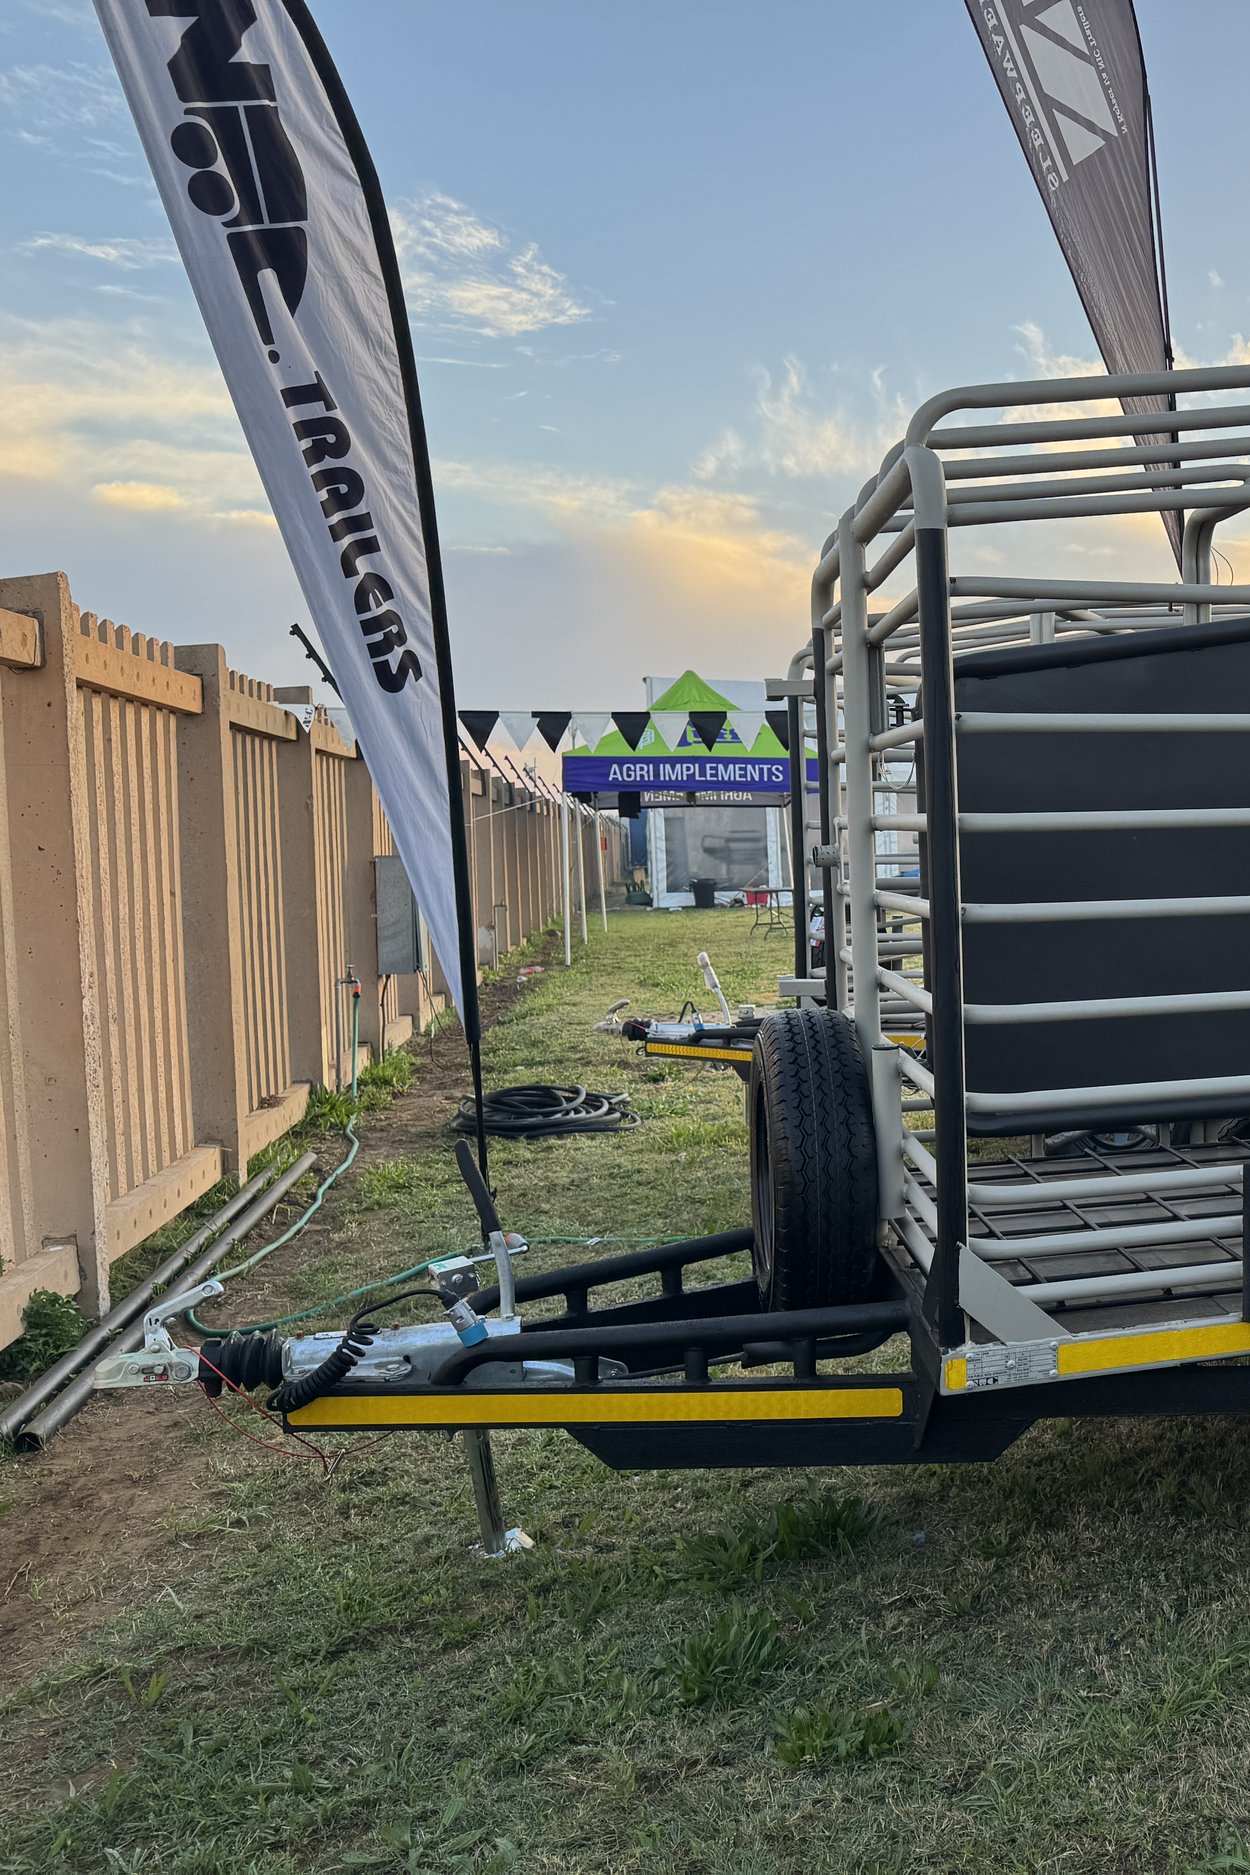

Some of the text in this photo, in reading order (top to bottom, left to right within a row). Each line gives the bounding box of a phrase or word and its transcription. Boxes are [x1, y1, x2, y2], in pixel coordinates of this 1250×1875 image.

[280, 370, 423, 694] TRAILERS
[608, 763, 784, 782] AGRI IMPLEMENTS
